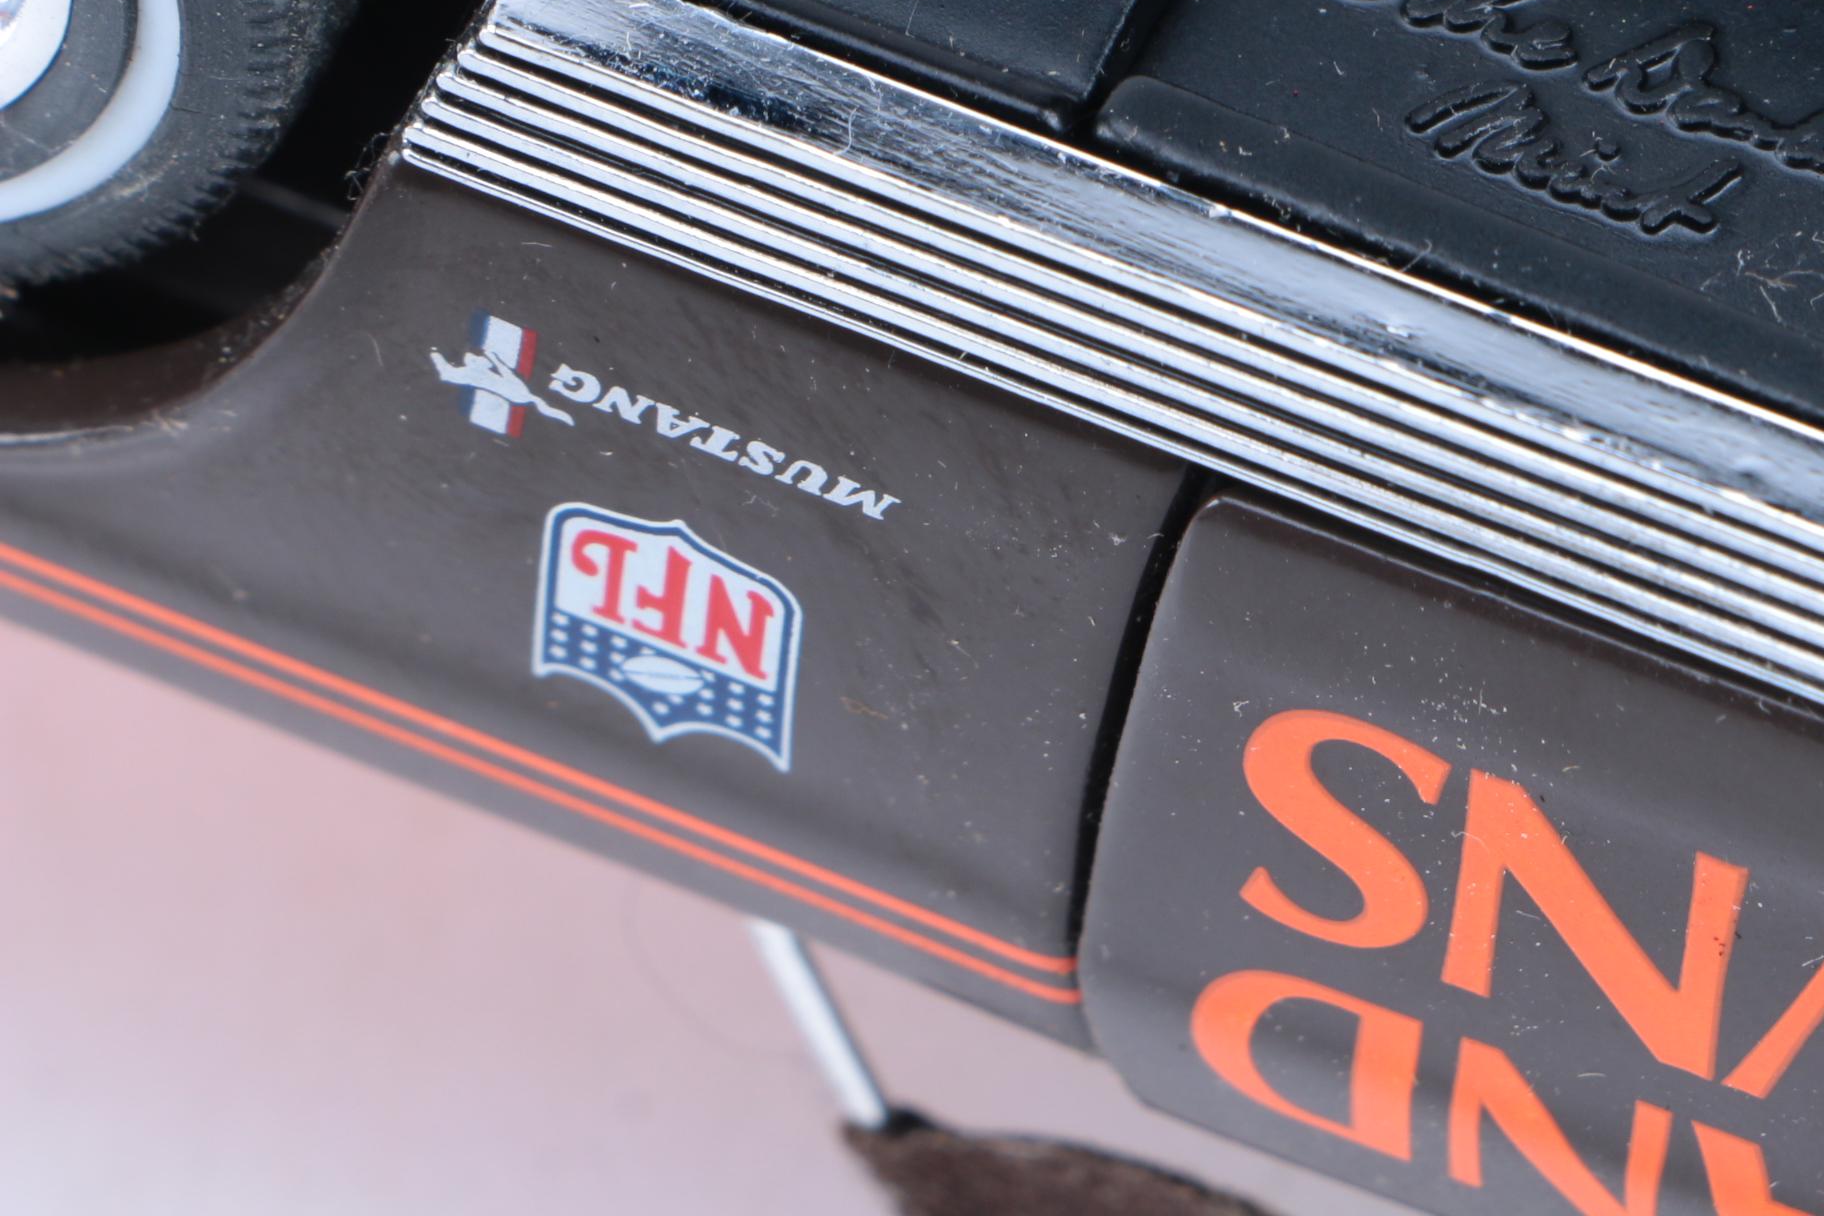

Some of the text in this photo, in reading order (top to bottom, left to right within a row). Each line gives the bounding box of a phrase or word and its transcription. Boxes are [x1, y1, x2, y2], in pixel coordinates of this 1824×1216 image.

[1405, 80, 1743, 235] Mint
[550, 364, 901, 520] MUSTANG
[570, 529, 774, 681] NFL
